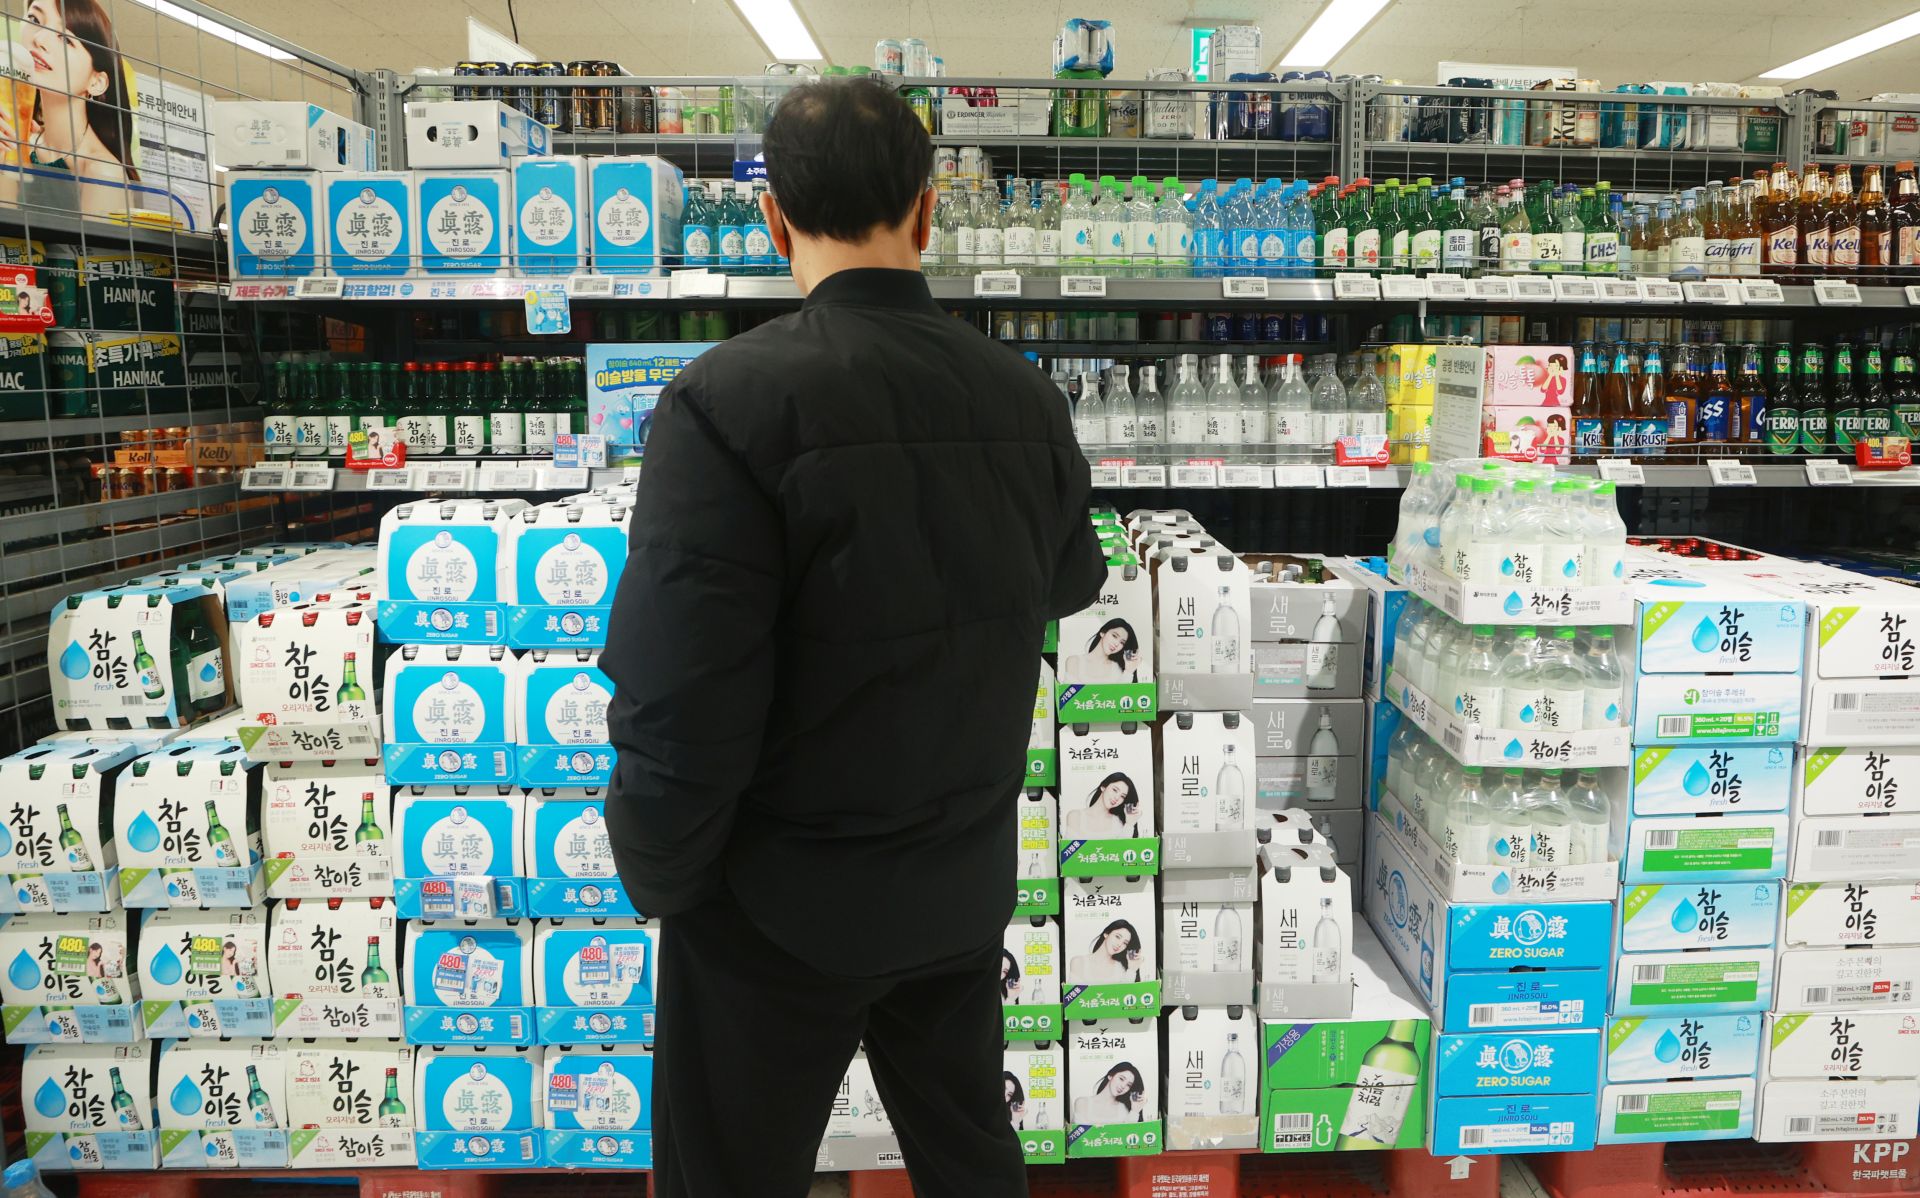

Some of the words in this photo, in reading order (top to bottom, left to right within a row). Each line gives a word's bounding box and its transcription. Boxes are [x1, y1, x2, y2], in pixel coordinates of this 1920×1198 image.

[1450, 235, 1466, 243] 좋은
[1450, 243, 1466, 252] 데이
[104, 287, 156, 306] HANMAC
[113, 370, 165, 388] HANMAC
[597, 368, 647, 388] 이슬방울
[1765, 417, 1799, 431] TERRA
[1634, 433, 1667, 446] KRUSH
[199, 447, 232, 462] Kelly
[1718, 656, 1738, 664] fresh
[1874, 662, 1900, 671] 오리지널
[94, 682, 114, 691] fresh
[1074, 698, 1117, 711] 처음처럼
[292, 728, 344, 752] 참이슬
[1068, 746, 1119, 761] 처음처럼
[1530, 739, 1573, 760] 참이슬
[1710, 798, 1728, 806] fresh
[1858, 801, 1883, 809] 오리지널
[164, 855, 186, 866] fresh
[1077, 851, 1120, 863] 처음처럼
[17, 859, 39, 870] fresh
[314, 862, 362, 888] 참이슬
[1072, 894, 1122, 907] 처음처럼
[1698, 934, 1715, 942] fresh
[1490, 947, 1523, 958] ZERO
[1524, 947, 1565, 958] SUGAR
[46, 992, 68, 1003] fresh
[186, 988, 208, 998] fresh
[1079, 996, 1121, 1008] 처음처럼
[322, 1004, 370, 1027] 참이슬
[1077, 1037, 1126, 1049] 처음처럼
[1275, 1029, 1301, 1053] 가정용
[1680, 1065, 1698, 1073] fresh
[1823, 1064, 1848, 1072] 오리지널
[1476, 1077, 1509, 1087] ZERO
[1511, 1076, 1551, 1086] SUGAR
[205, 1118, 226, 1128] fresh
[1498, 1114, 1519, 1122] JINRO
[70, 1119, 92, 1130] fresh
[338, 1134, 385, 1158] 참이슬
[1083, 1136, 1123, 1147] 처음처럼
[1853, 1142, 1910, 1163] KPP
[1853, 1168, 1907, 1180] 한국파렛트풀
